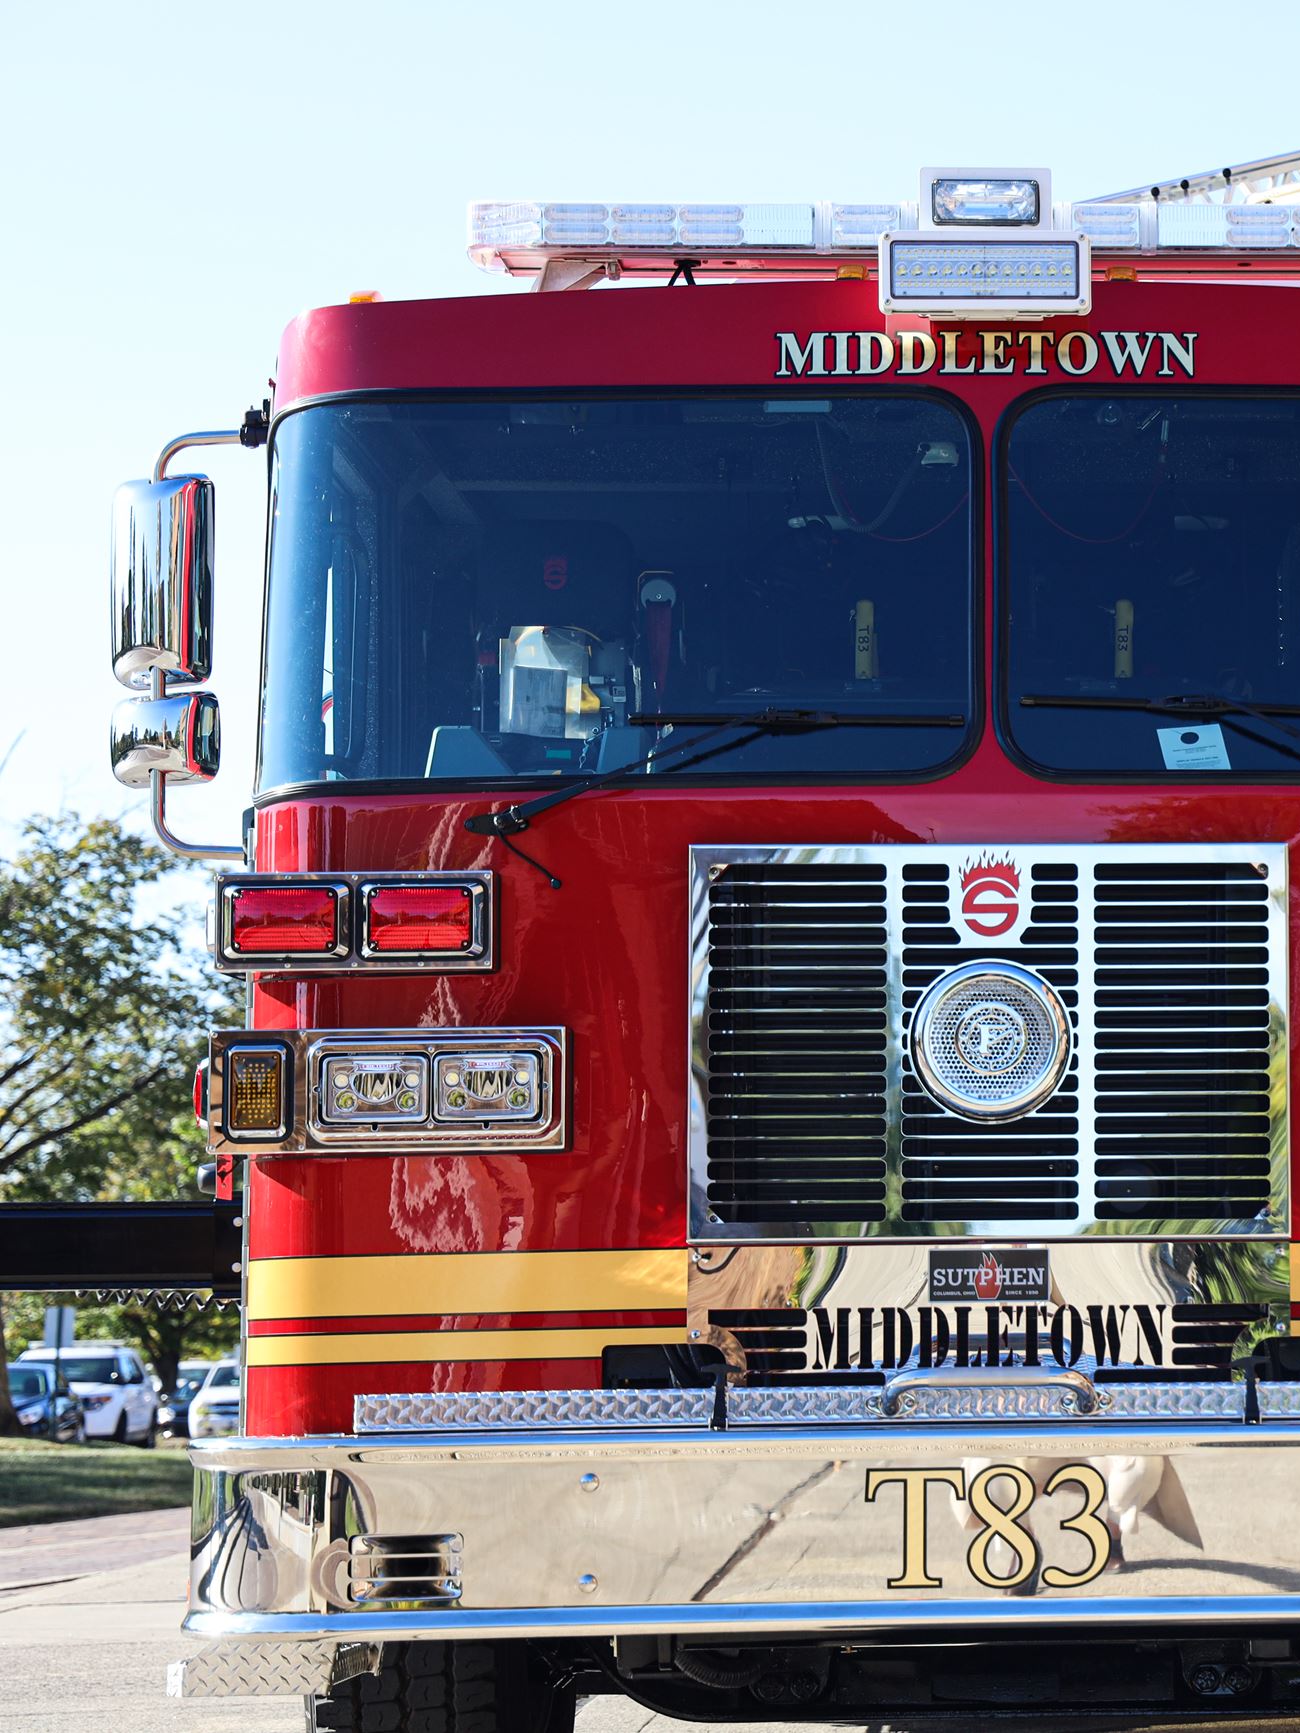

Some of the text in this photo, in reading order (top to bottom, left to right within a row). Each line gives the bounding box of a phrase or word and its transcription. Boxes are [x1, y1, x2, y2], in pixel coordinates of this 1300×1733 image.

[775, 331, 1197, 376] MIDDLETOWN
[858, 625, 870, 652] T83
[1117, 625, 1129, 651] T83
[962, 880, 1019, 937] S
[933, 1267, 1045, 1287] SUTPHEN
[812, 1304, 1166, 1369] MIDDLETOWN
[865, 1464, 1112, 1590] T83
